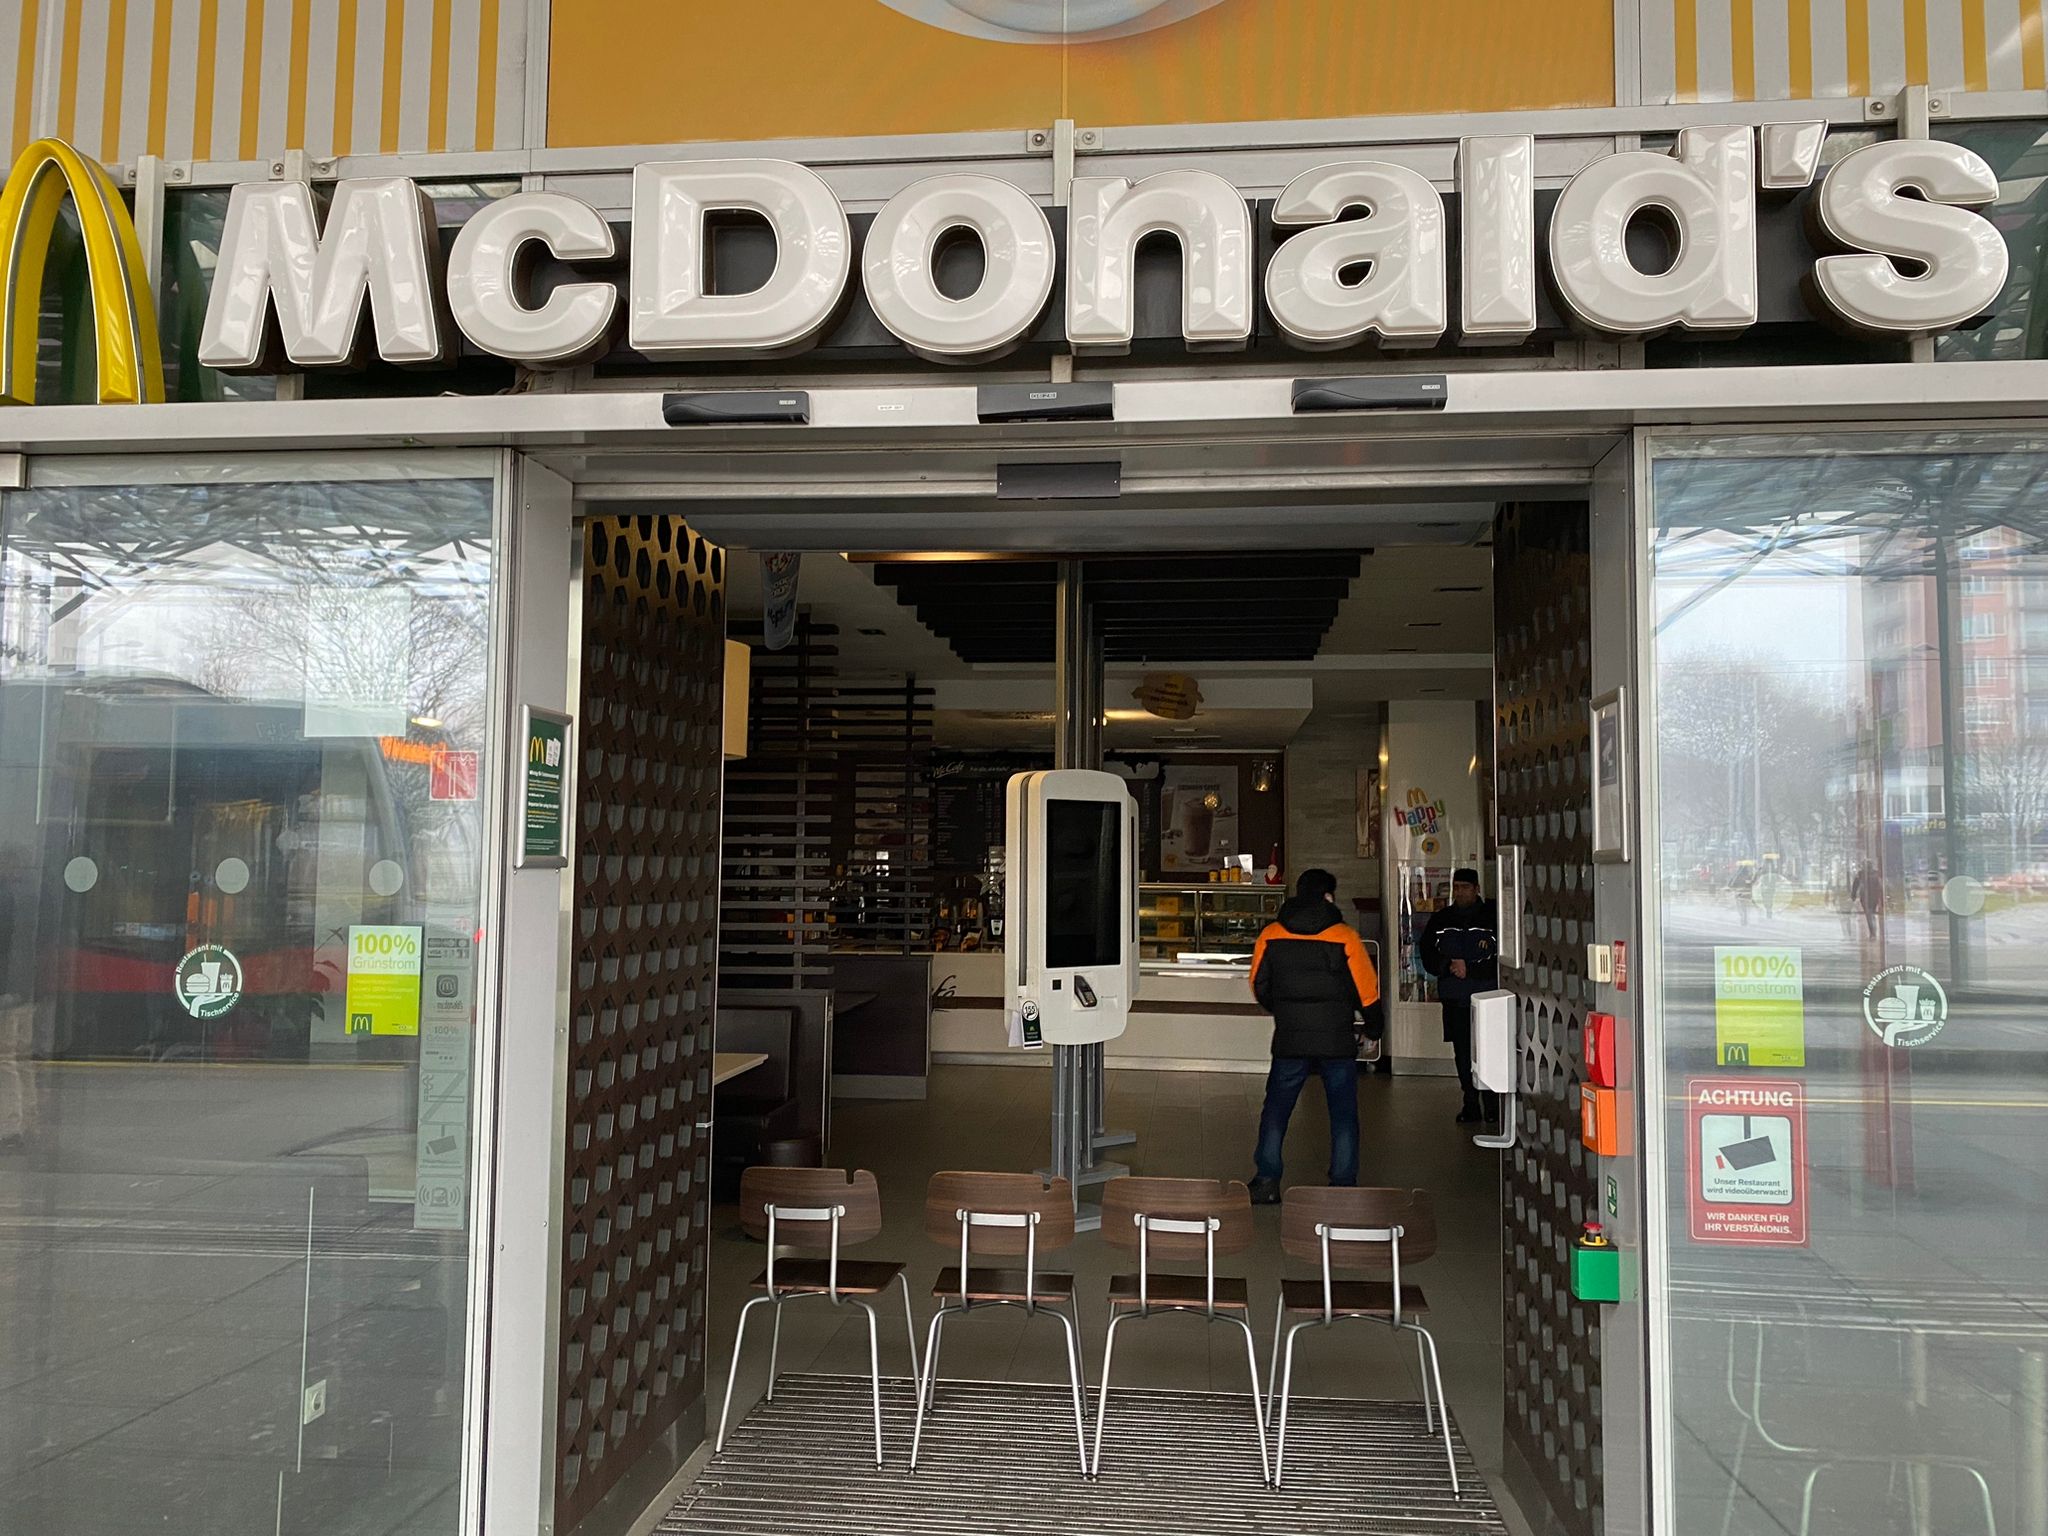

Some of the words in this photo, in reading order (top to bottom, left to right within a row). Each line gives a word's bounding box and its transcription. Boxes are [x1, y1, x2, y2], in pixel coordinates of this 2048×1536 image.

[197, 119, 2010, 368] McDonald's
[1394, 799, 1445, 827] happy
[1410, 821, 1439, 837] meal
[354, 932, 416, 955] 100%
[175, 943, 209, 973] Restaurant
[210, 944, 223, 952] mit
[353, 956, 416, 970] Grünstrom
[1722, 955, 1796, 978] 100%
[1863, 964, 1904, 996] Restaurant
[1905, 965, 1921, 975] mit
[200, 992, 240, 1017] Tischservice
[1896, 1021, 1945, 1047] Tischservice
[1698, 1089, 1794, 1107] ACHTUNG
[1714, 1178, 1736, 1186] Unser
[1738, 1178, 1780, 1187] Restaurant
[1725, 1187, 1788, 1196] videoüberwacht!
[1704, 1223, 1722, 1232] IHR
[1723, 1223, 1792, 1234] VERSTÄNDNIS.
[1706, 1212, 1726, 1221] WIR
[1727, 1213, 1768, 1222] DANKEN
[1769, 1213, 1790, 1223] FÜR
